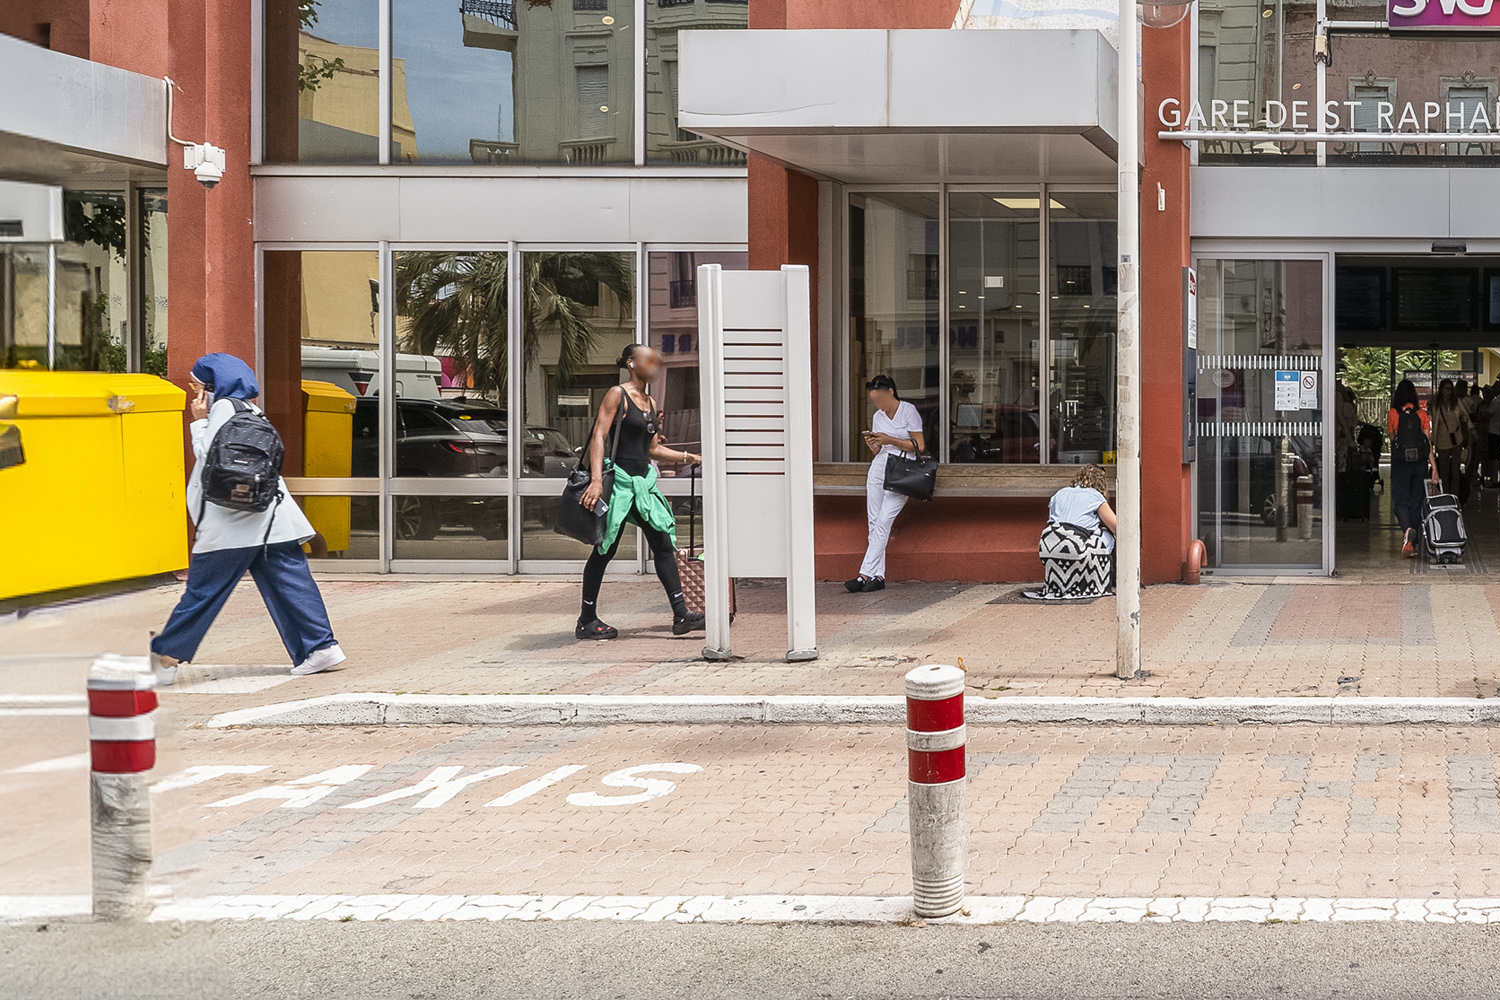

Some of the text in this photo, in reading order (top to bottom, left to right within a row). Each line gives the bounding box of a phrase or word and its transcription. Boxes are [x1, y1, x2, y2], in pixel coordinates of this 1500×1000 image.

[1158, 98, 1250, 127] GARE
[1266, 100, 1309, 129] DE
[1324, 100, 1362, 130] ST
[148, 762, 704, 809] TAXIS
